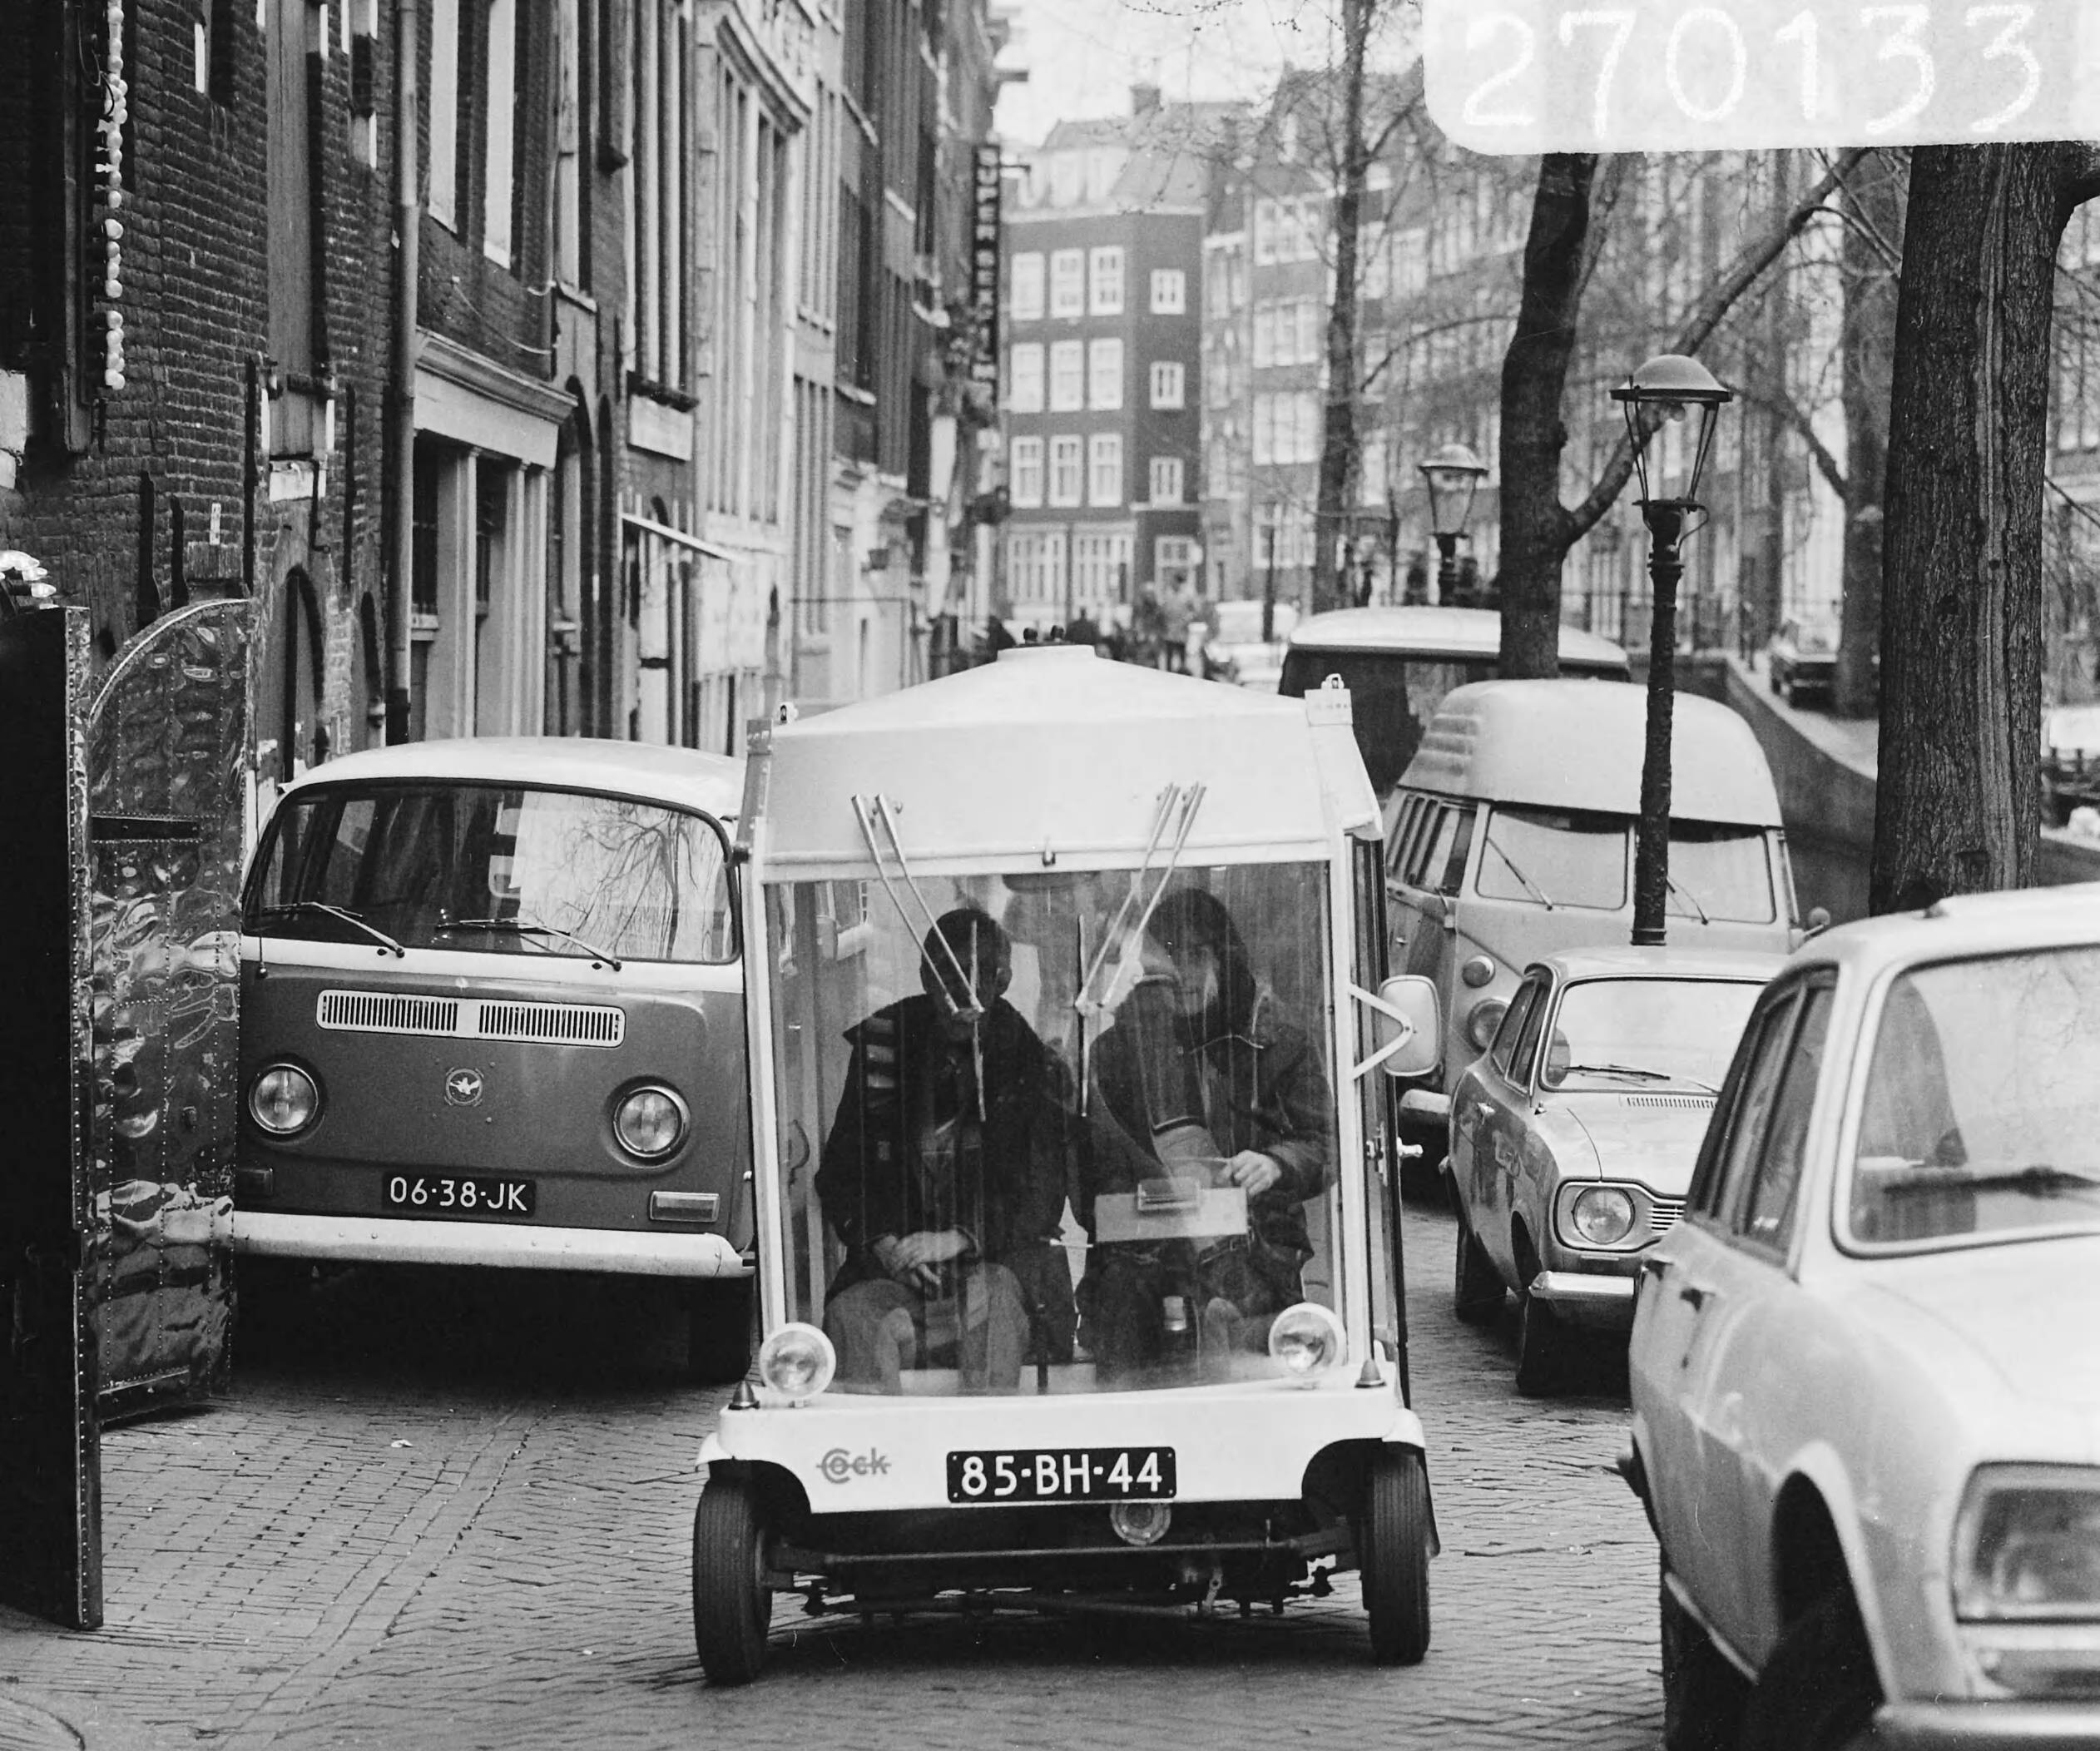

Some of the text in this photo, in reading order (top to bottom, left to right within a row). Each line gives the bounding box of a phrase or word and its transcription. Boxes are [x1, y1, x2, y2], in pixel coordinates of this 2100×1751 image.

[977, 148, 998, 241] SUPER
[390, 1177, 527, 1212] 06-38-JK
[961, 1452, 1162, 1496] 85-BH-44
